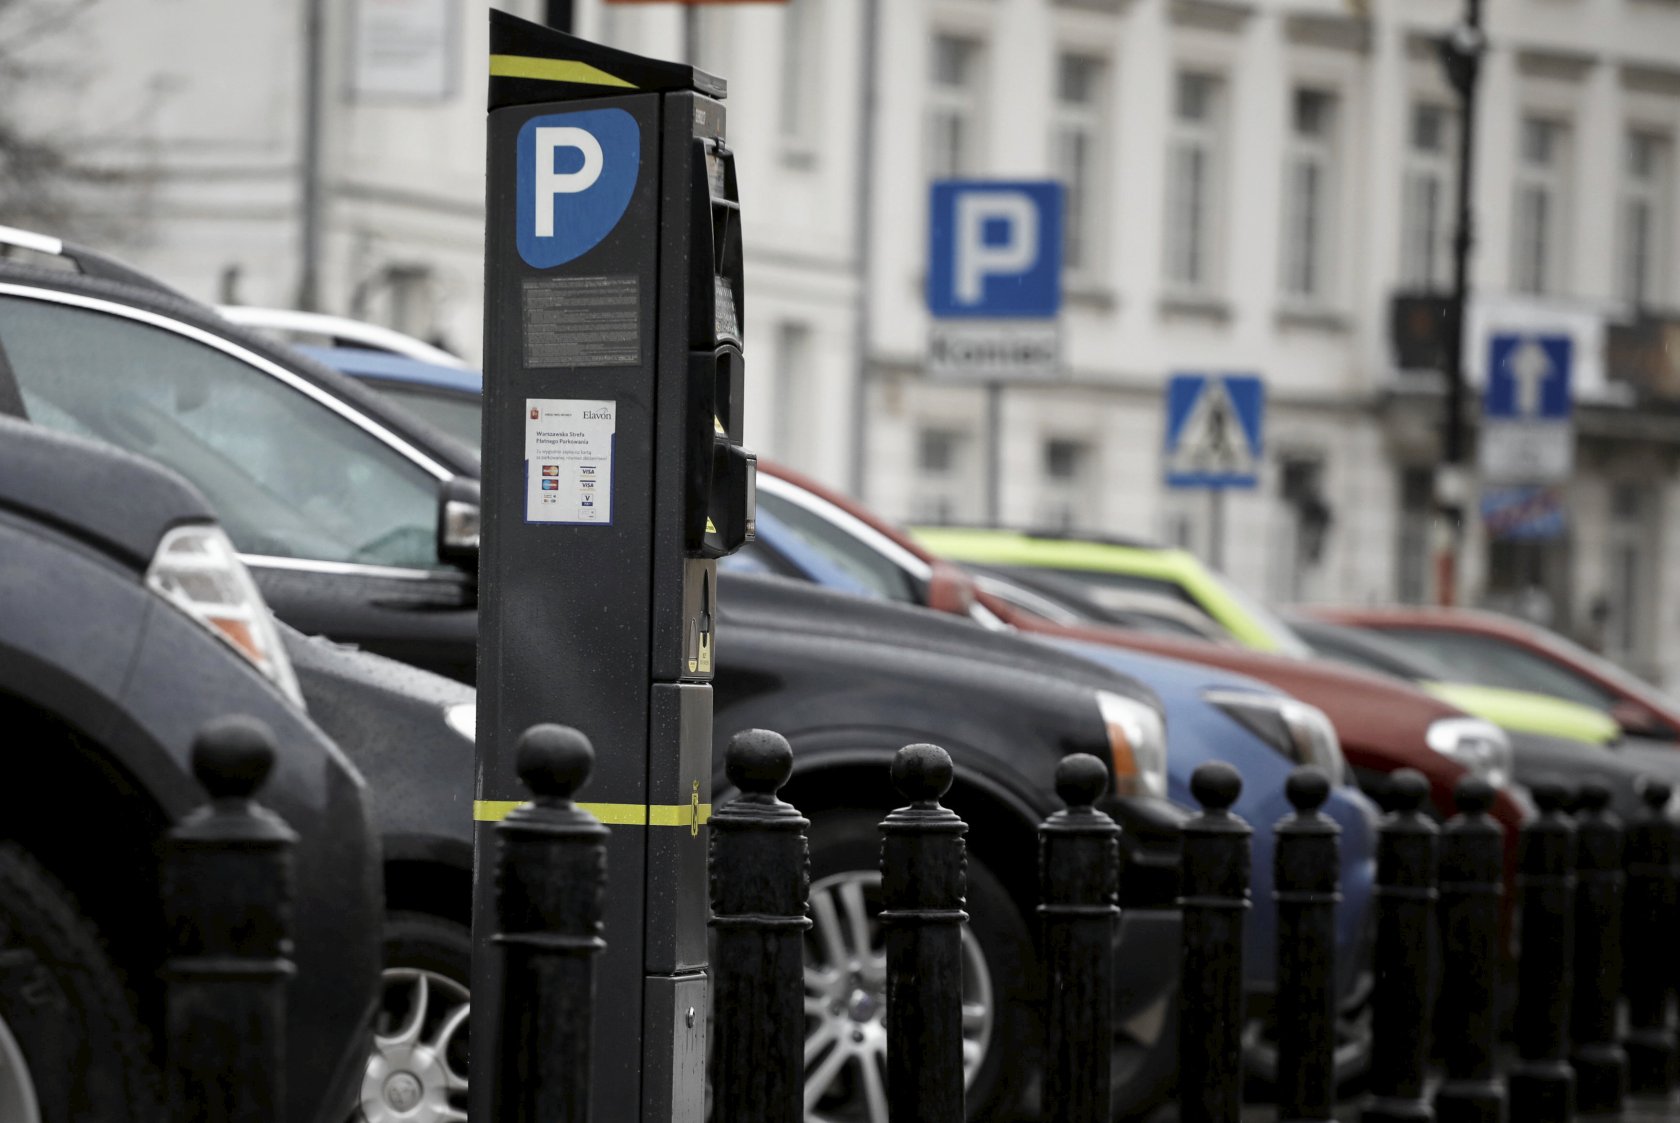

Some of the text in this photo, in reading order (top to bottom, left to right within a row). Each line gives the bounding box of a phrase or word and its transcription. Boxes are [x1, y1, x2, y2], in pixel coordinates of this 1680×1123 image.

[535, 127, 604, 237] P
[955, 191, 1039, 304] P
[583, 410, 612, 420] Elavon
